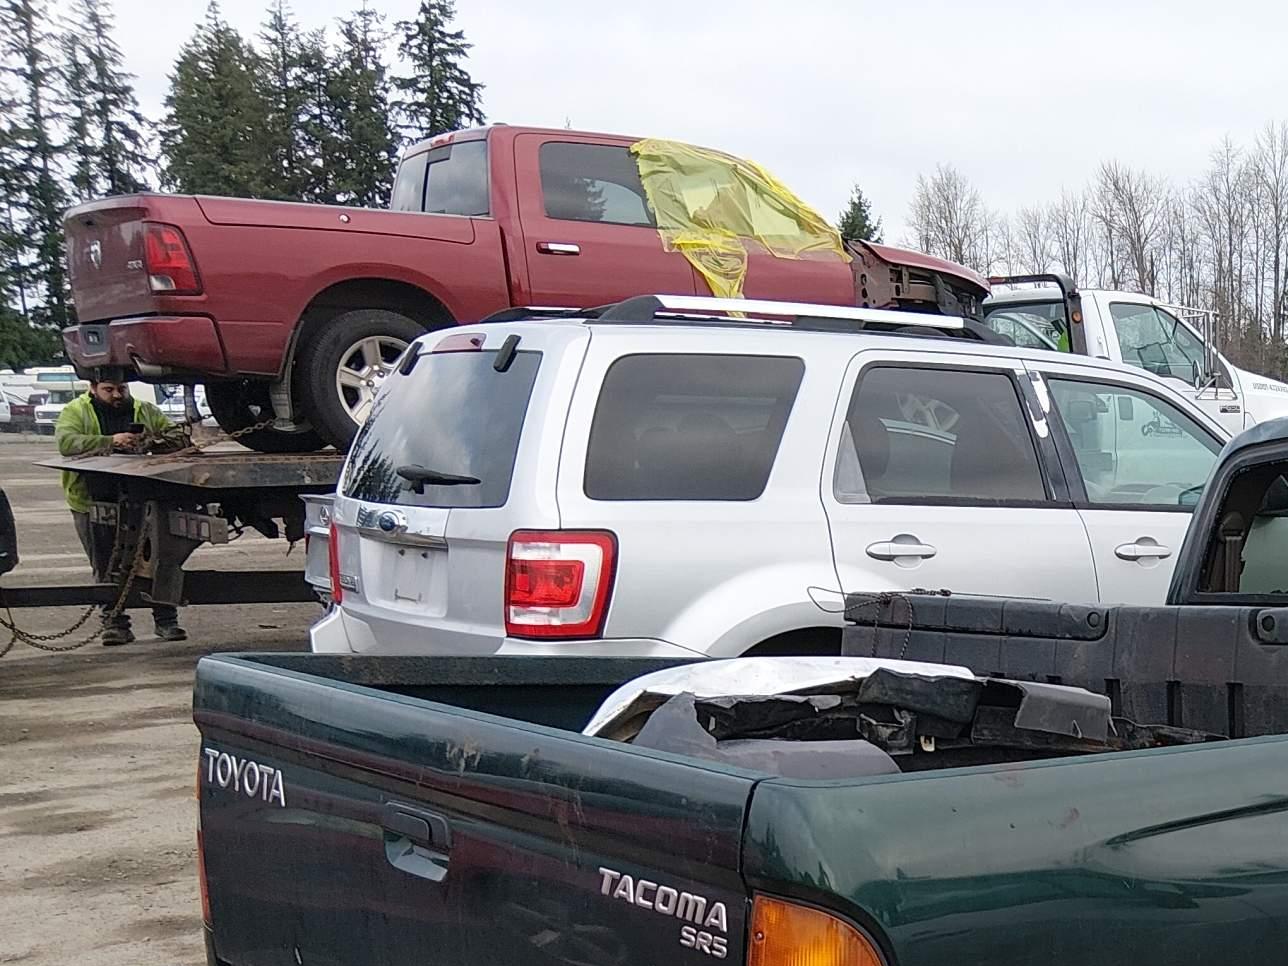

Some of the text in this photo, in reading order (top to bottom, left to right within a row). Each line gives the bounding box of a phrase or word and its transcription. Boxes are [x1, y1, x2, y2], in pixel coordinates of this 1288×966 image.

[204, 747, 286, 807] TOYOTA
[598, 866, 728, 933] TACOMA
[679, 925, 728, 959] SR5
